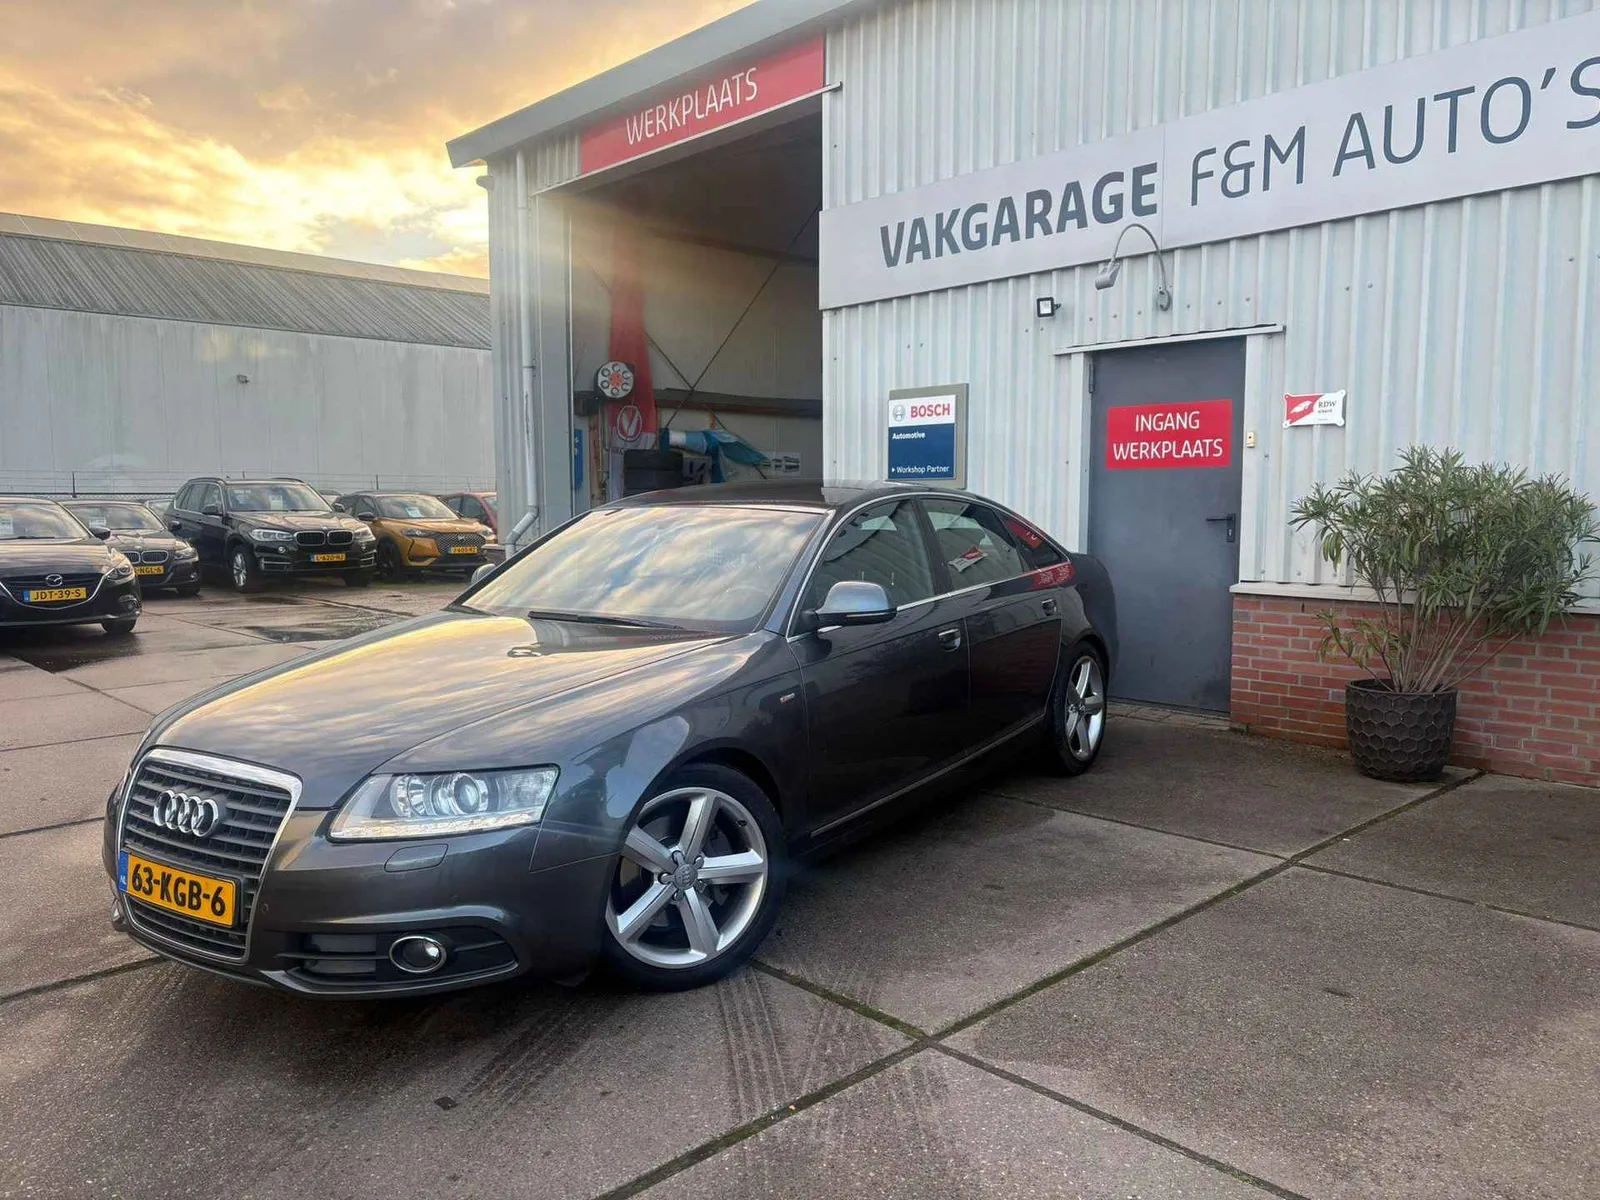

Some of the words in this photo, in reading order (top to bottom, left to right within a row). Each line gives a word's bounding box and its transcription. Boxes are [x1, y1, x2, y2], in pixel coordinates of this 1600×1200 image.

[626, 67, 758, 145] WERKPLAATS
[880, 162, 1157, 268] VAKGARAGE
[1191, 126, 1306, 206] F&M
[1332, 55, 1600, 177] AUTO'S
[910, 403, 951, 418] BOSCH
[1318, 400, 1337, 408] RDW
[1135, 411, 1200, 432] INGANG
[892, 431, 926, 440] Automotive
[1113, 438, 1223, 460] WERKPLAATS
[896, 466, 926, 474] Workshop
[927, 465, 950, 473] Partner
[34, 589, 81, 600] JDT-39-S
[131, 863, 226, 917] 63-KGB-6
